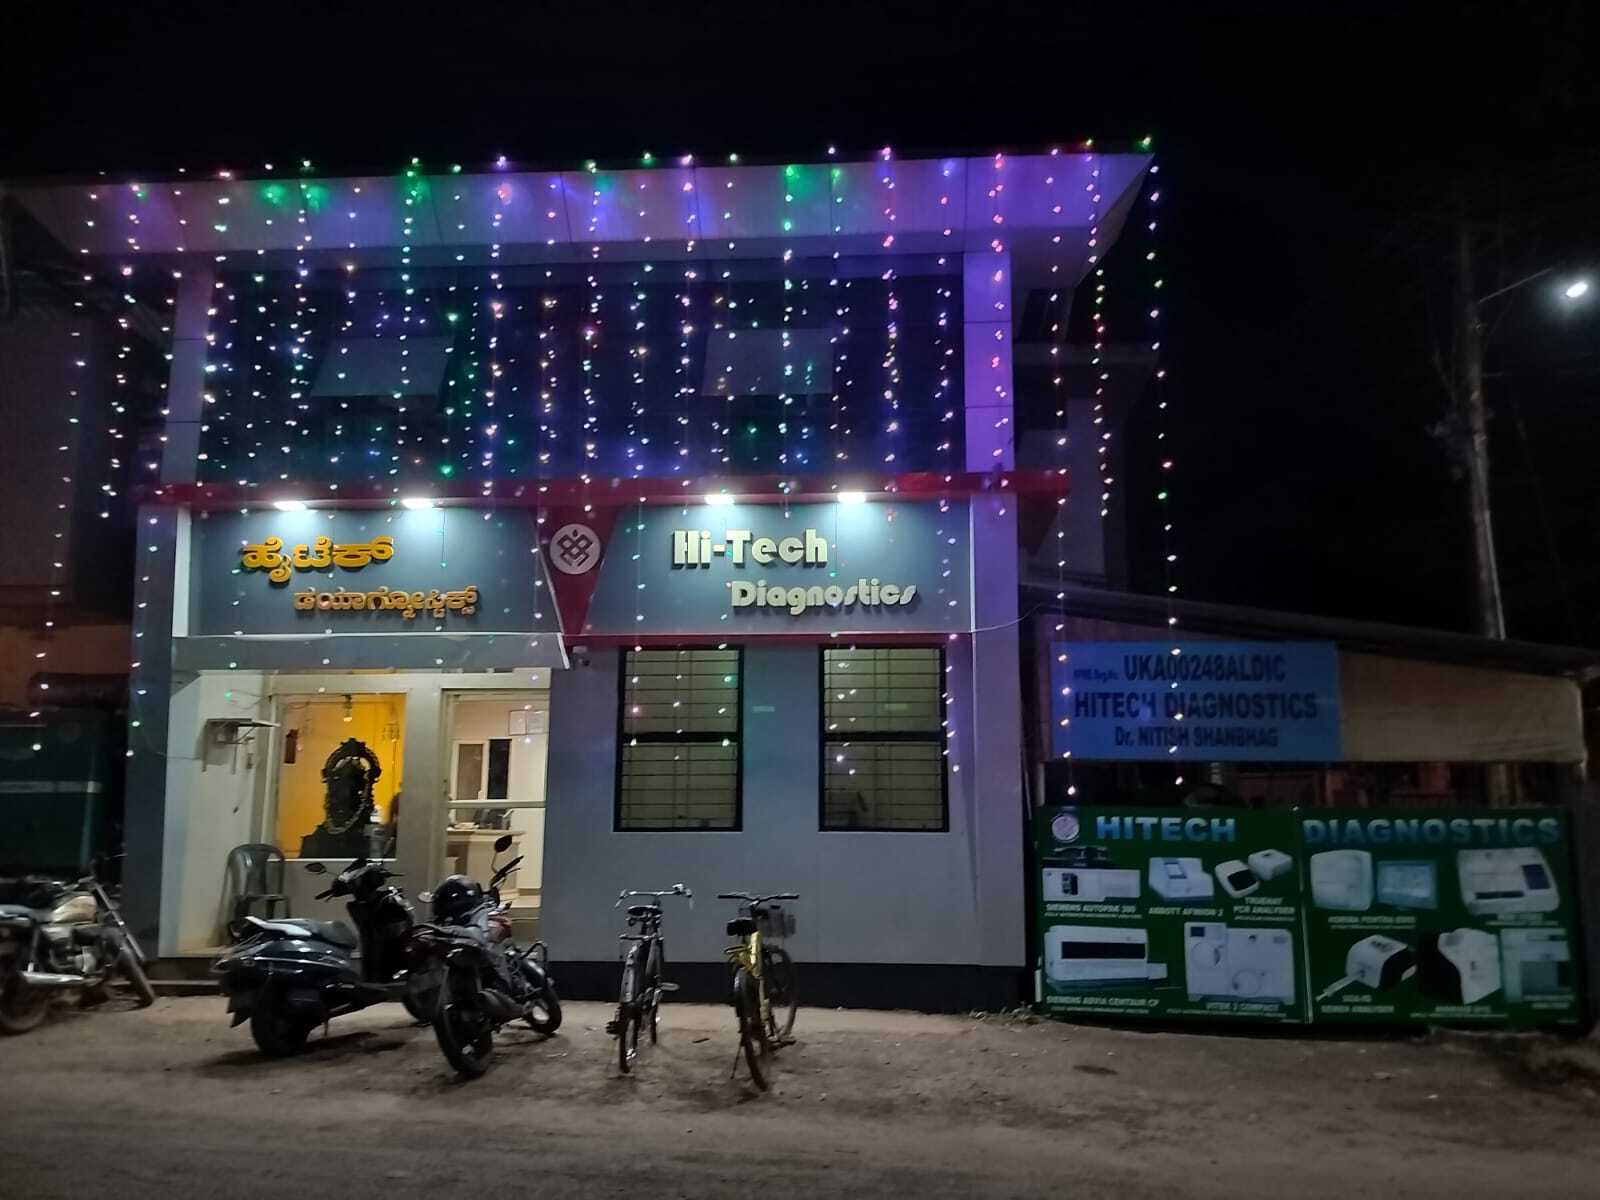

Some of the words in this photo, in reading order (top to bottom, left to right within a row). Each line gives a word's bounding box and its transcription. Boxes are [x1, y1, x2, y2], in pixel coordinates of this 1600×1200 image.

[242, 535, 394, 583] ಹೈಟೆಕ್
[673, 529, 828, 564] Hi-Tech
[731, 579, 917, 615] Diagnostics
[1074, 693, 1155, 718] HITECH
[1165, 693, 1317, 719] DIAGNOSTICS
[1115, 727, 1134, 746] Dr.
[1138, 727, 1191, 747] NITISH
[1193, 727, 1278, 747] SHANBHAG
[1096, 816, 1236, 842] HITECH
[1302, 817, 1560, 844] DIAGNOSTICS
